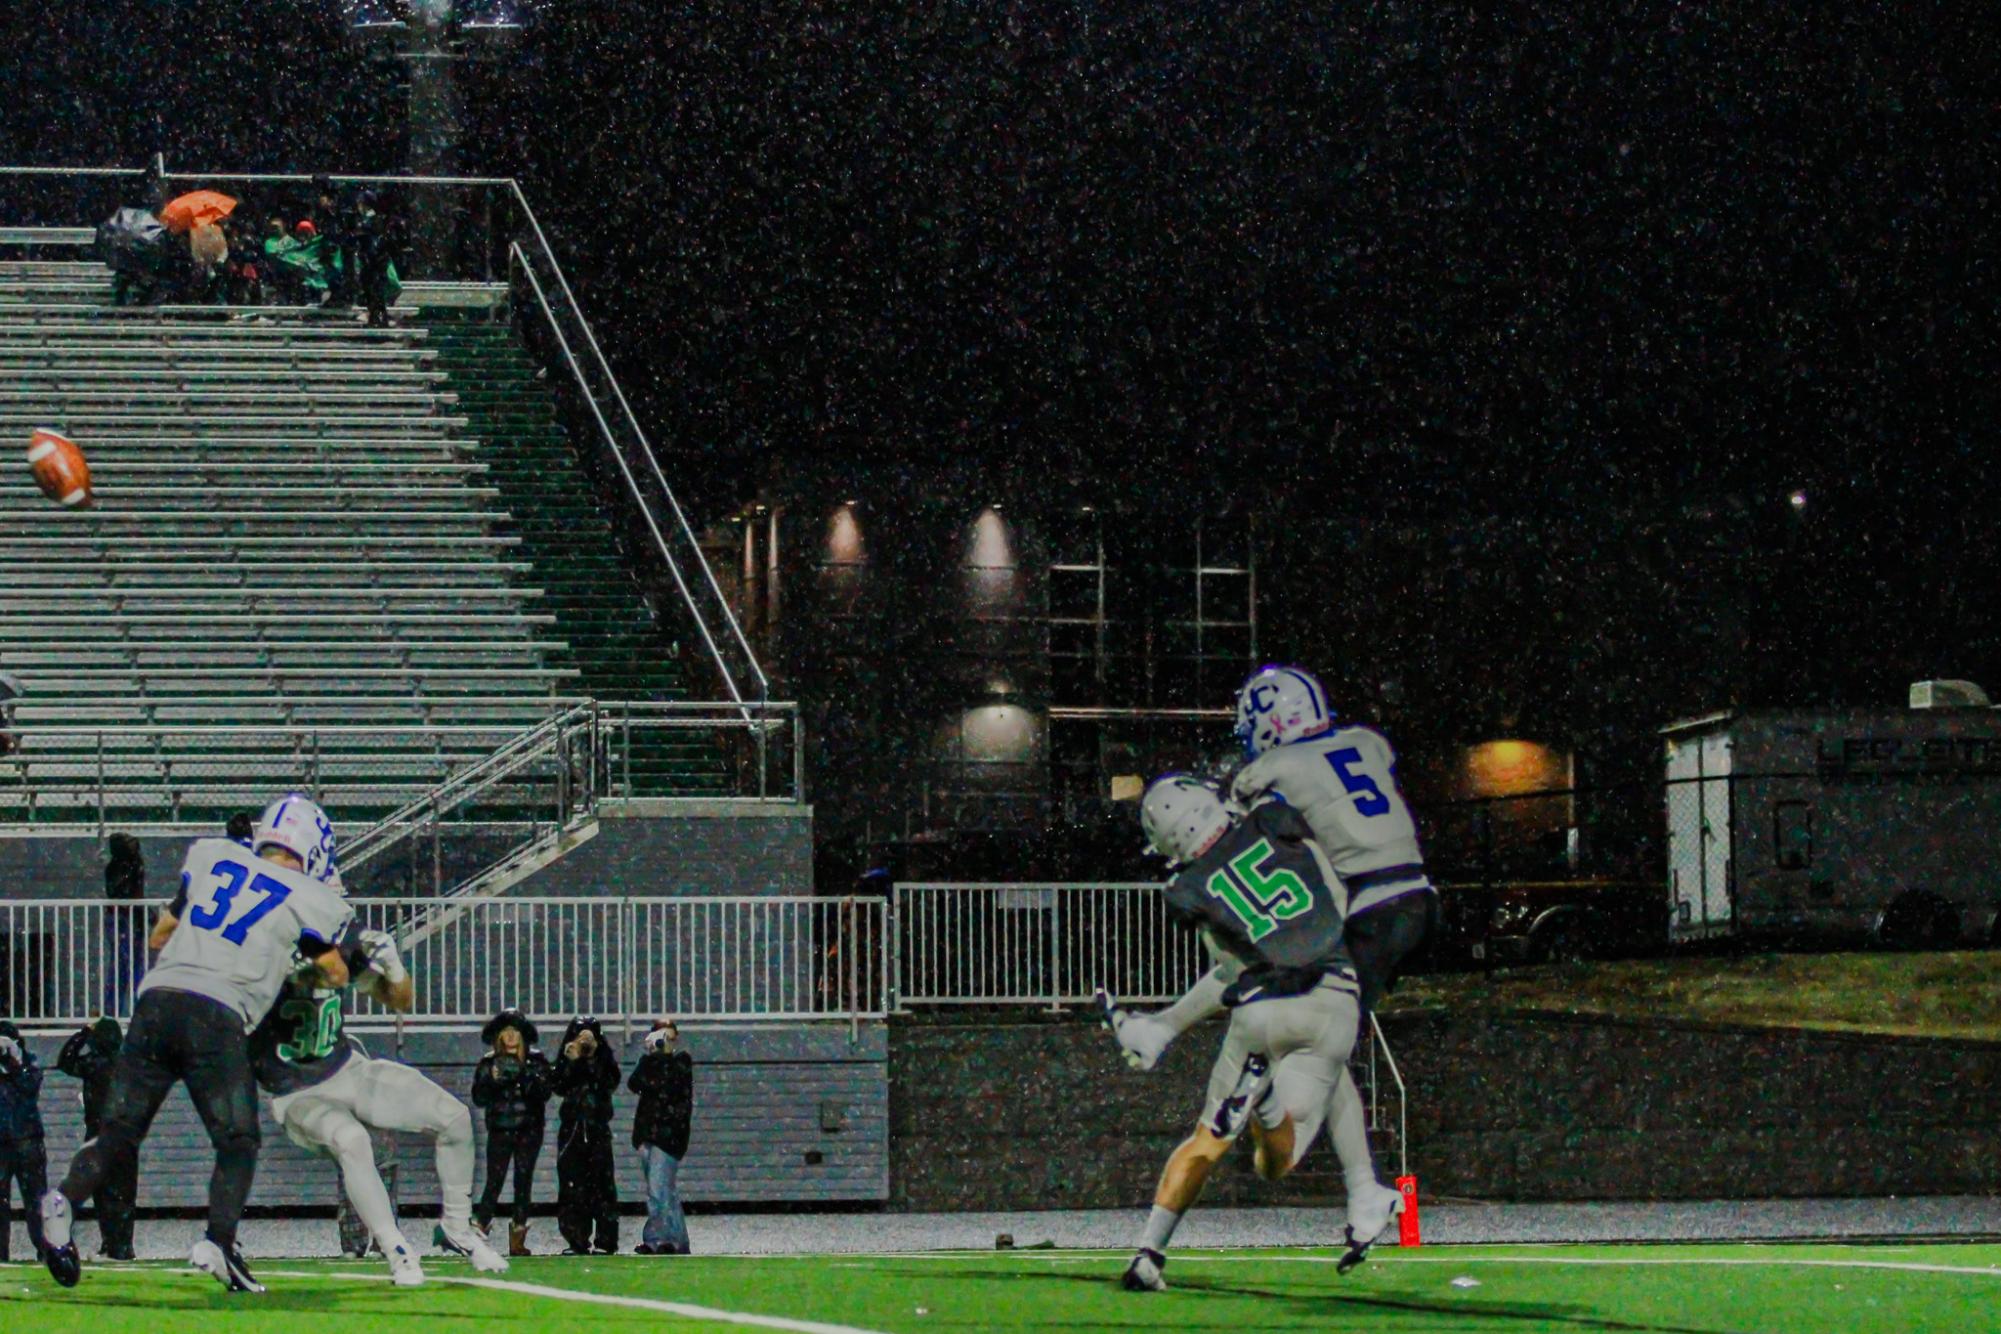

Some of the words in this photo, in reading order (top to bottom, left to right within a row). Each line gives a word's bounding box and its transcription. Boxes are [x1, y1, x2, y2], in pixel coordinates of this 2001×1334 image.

[1324, 747, 1390, 817] 5
[190, 859, 292, 946] 37
[1206, 837, 1314, 945] 15
[276, 995, 342, 1062] 30
